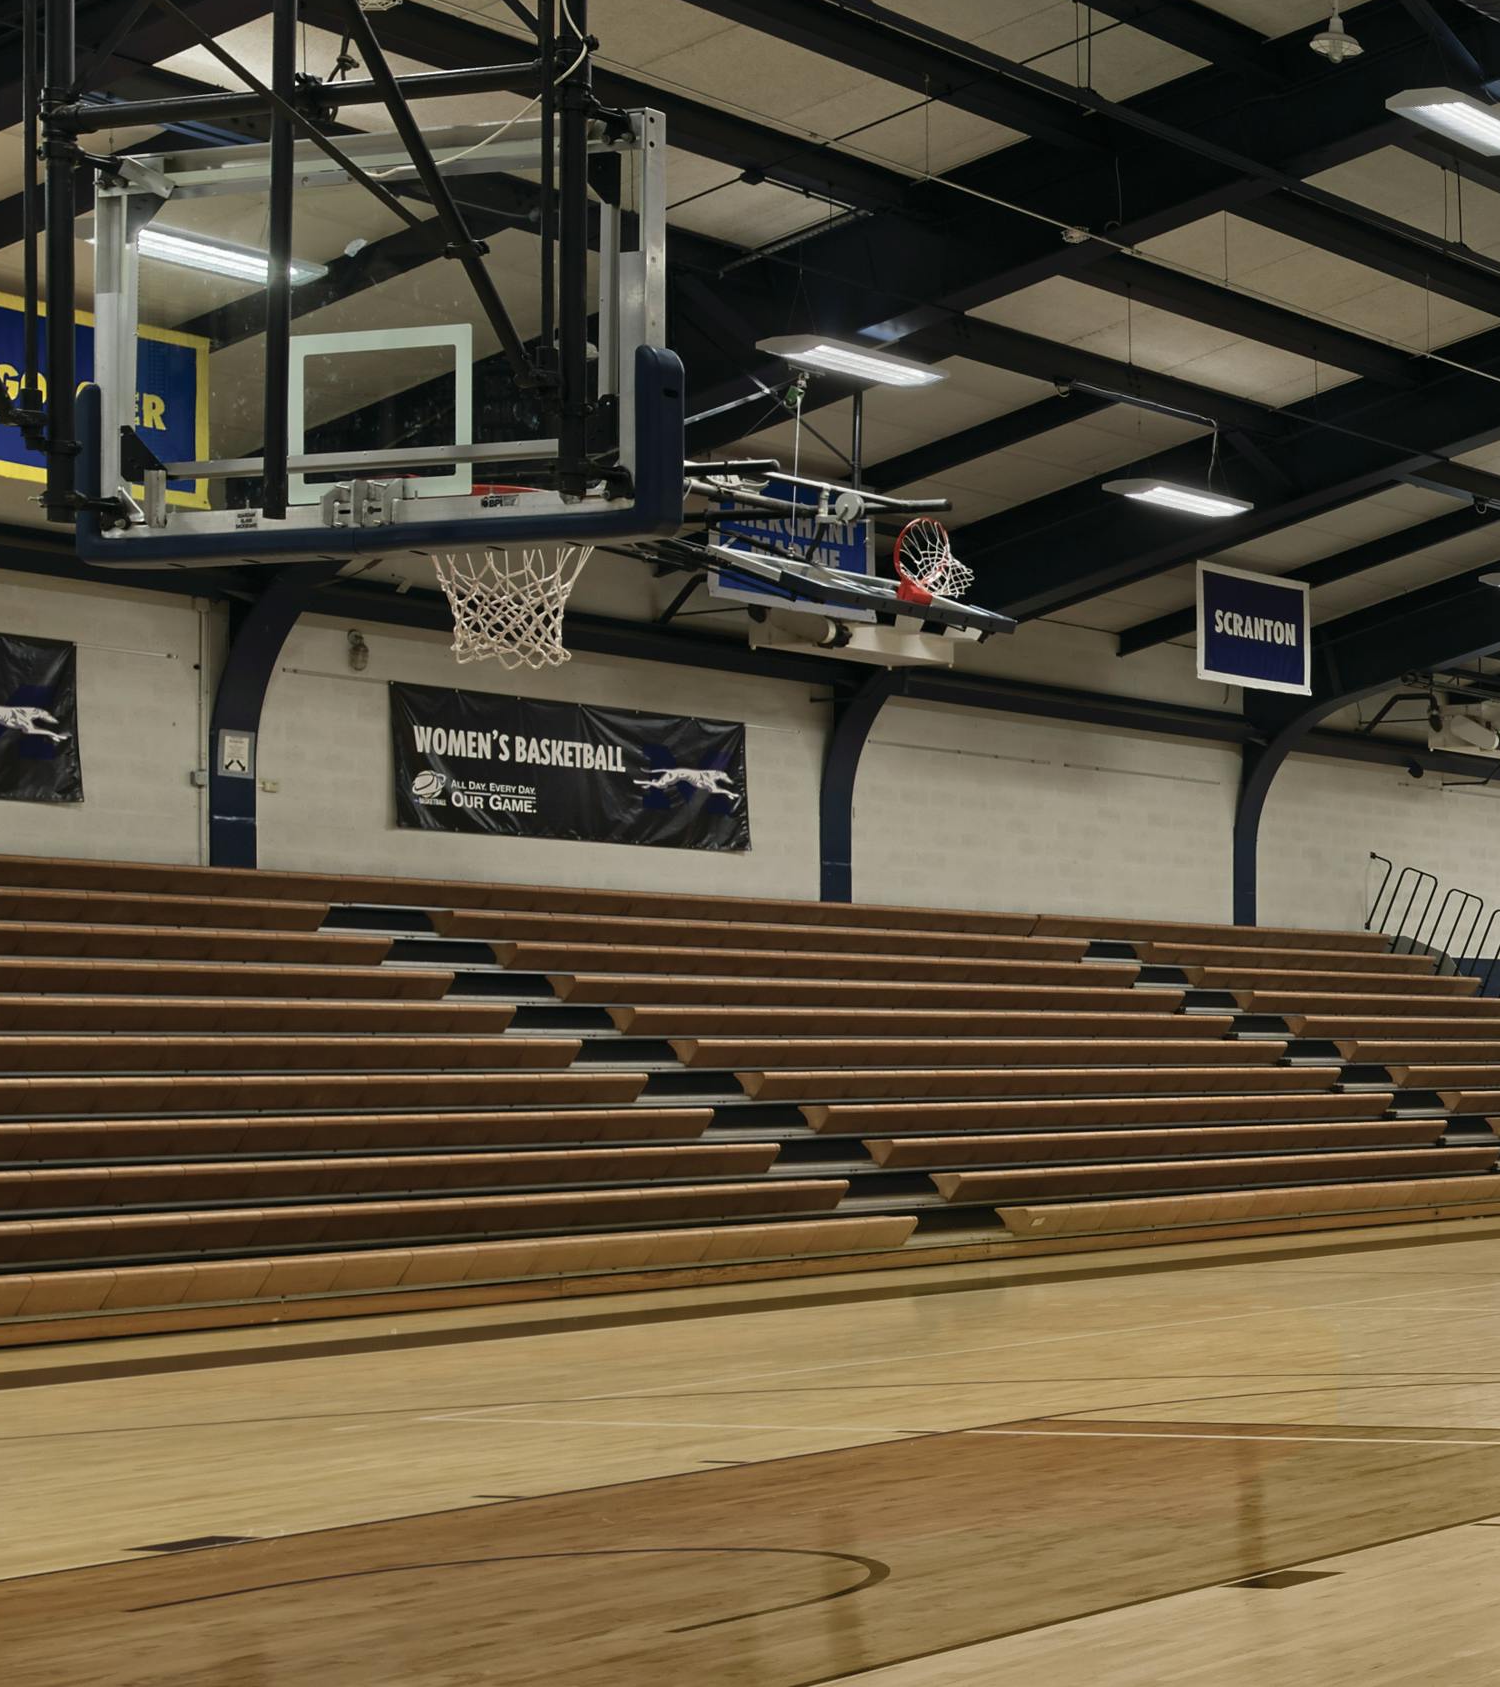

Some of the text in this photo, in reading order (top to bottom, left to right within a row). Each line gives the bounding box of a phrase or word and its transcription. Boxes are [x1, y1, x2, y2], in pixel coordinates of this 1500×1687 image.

[1215, 609, 1297, 646] SCRANTON
[413, 725, 626, 772] WOMEN'S BASKETBALL
[451, 779, 467, 790] ALL
[489, 783, 516, 794] EVERY
[451, 791, 484, 809] OUR
